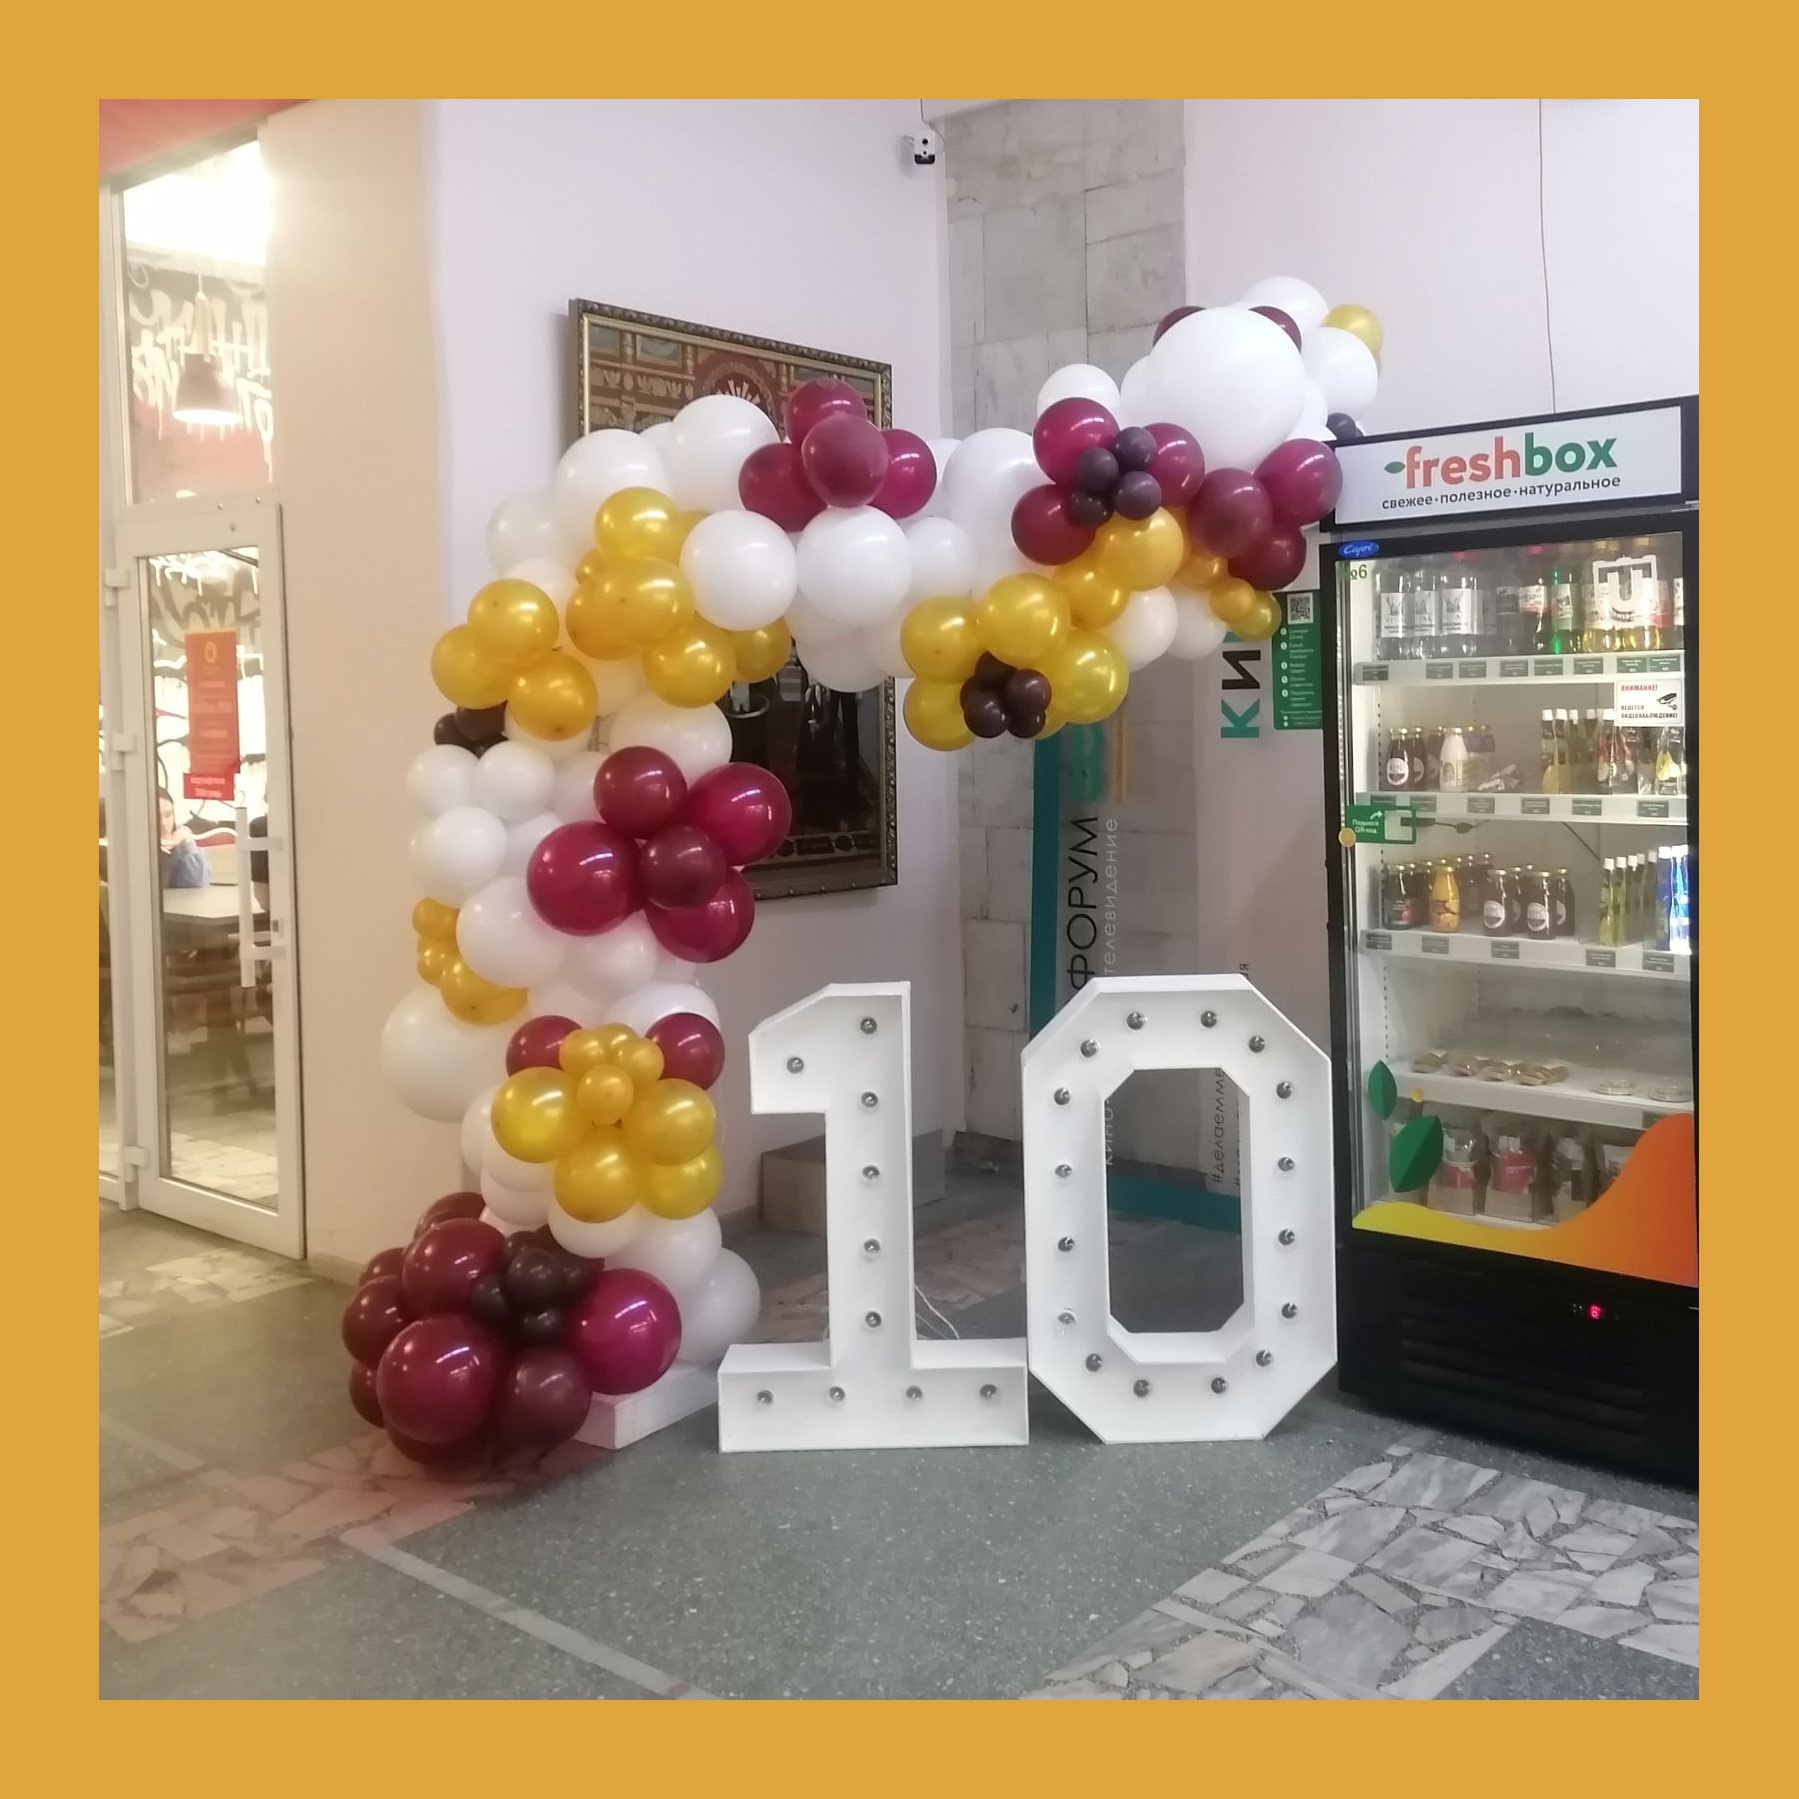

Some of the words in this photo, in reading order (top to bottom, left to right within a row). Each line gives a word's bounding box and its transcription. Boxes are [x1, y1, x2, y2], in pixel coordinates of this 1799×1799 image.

[1382, 495, 1433, 510] свежее
[1440, 487, 1512, 504] полезное
[1519, 476, 1621, 498] натуральное
[1406, 432, 1618, 489] freshbox
[1066, 816, 1099, 990] ФОРУМ
[718, 974, 1338, 1453] 10
